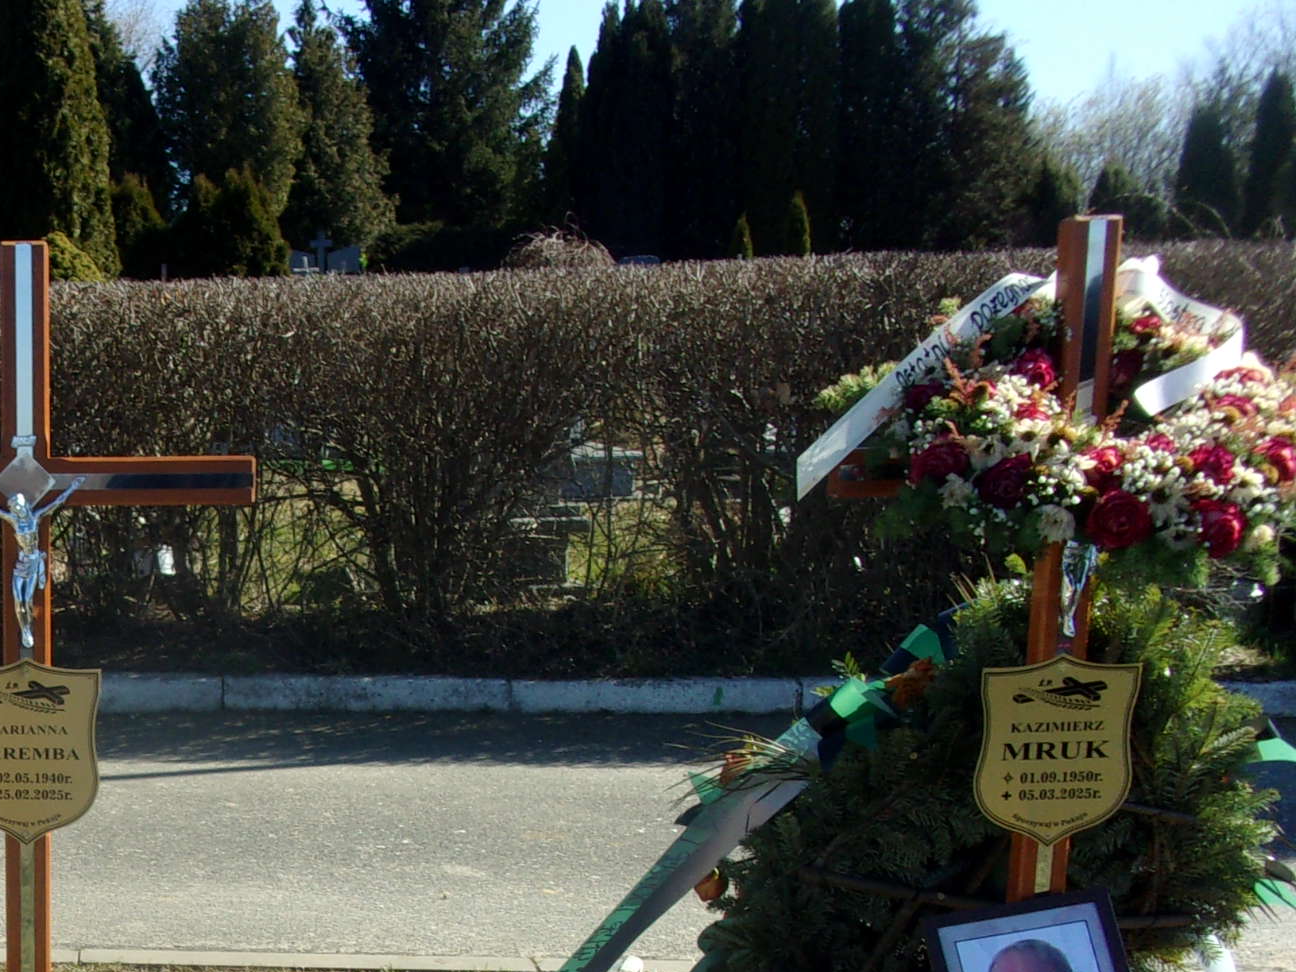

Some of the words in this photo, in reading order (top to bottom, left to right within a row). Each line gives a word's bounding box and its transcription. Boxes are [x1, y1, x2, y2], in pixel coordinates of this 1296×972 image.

[1010, 720, 1105, 734] KAZIMIERZ
[1001, 740, 1110, 762] MRUK
[1019, 770, 1104, 785] 01.09.1950r.
[1018, 787, 1103, 801] 05.03.2025r.
